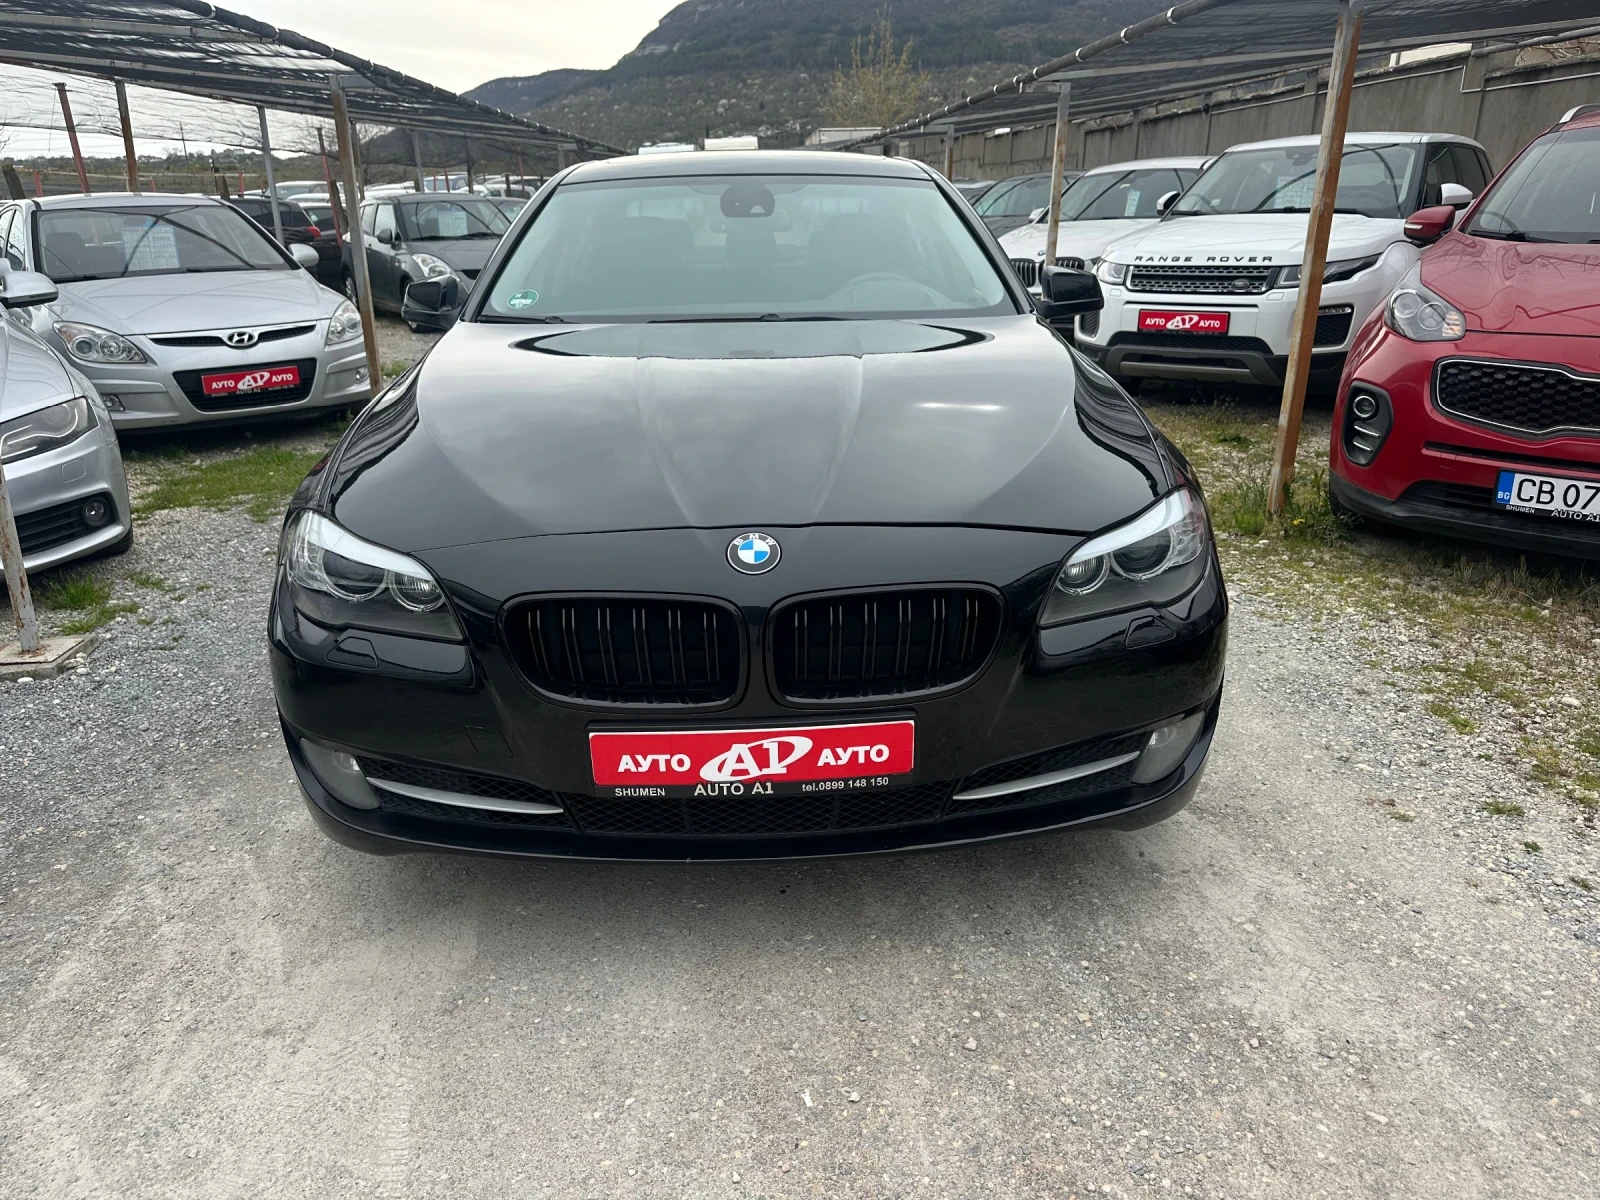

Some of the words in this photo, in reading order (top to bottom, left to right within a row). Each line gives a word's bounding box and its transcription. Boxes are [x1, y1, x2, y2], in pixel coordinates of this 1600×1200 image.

[1134, 255, 1193, 263] RANGE
[1199, 320, 1221, 328] АУТО
[212, 380, 235, 389] АУТО
[272, 373, 293, 382] АУТО
[1497, 491, 1510, 500] BG
[1516, 478, 1555, 505] CB
[1562, 483, 1600, 510] 07
[1505, 504, 1535, 514] SHUMEN
[1551, 508, 1583, 520] AUTO
[1586, 513, 1600, 522] A1
[733, 533, 776, 546] BMW
[617, 753, 692, 773] АУТО
[817, 744, 890, 767] АУТО
[694, 782, 745, 796] AUTO
[751, 782, 774, 795] A1
[801, 781, 845, 792] tel.0899
[848, 779, 867, 788] 148
[870, 777, 889, 786] 150
[614, 787, 666, 797] SHUMEN
